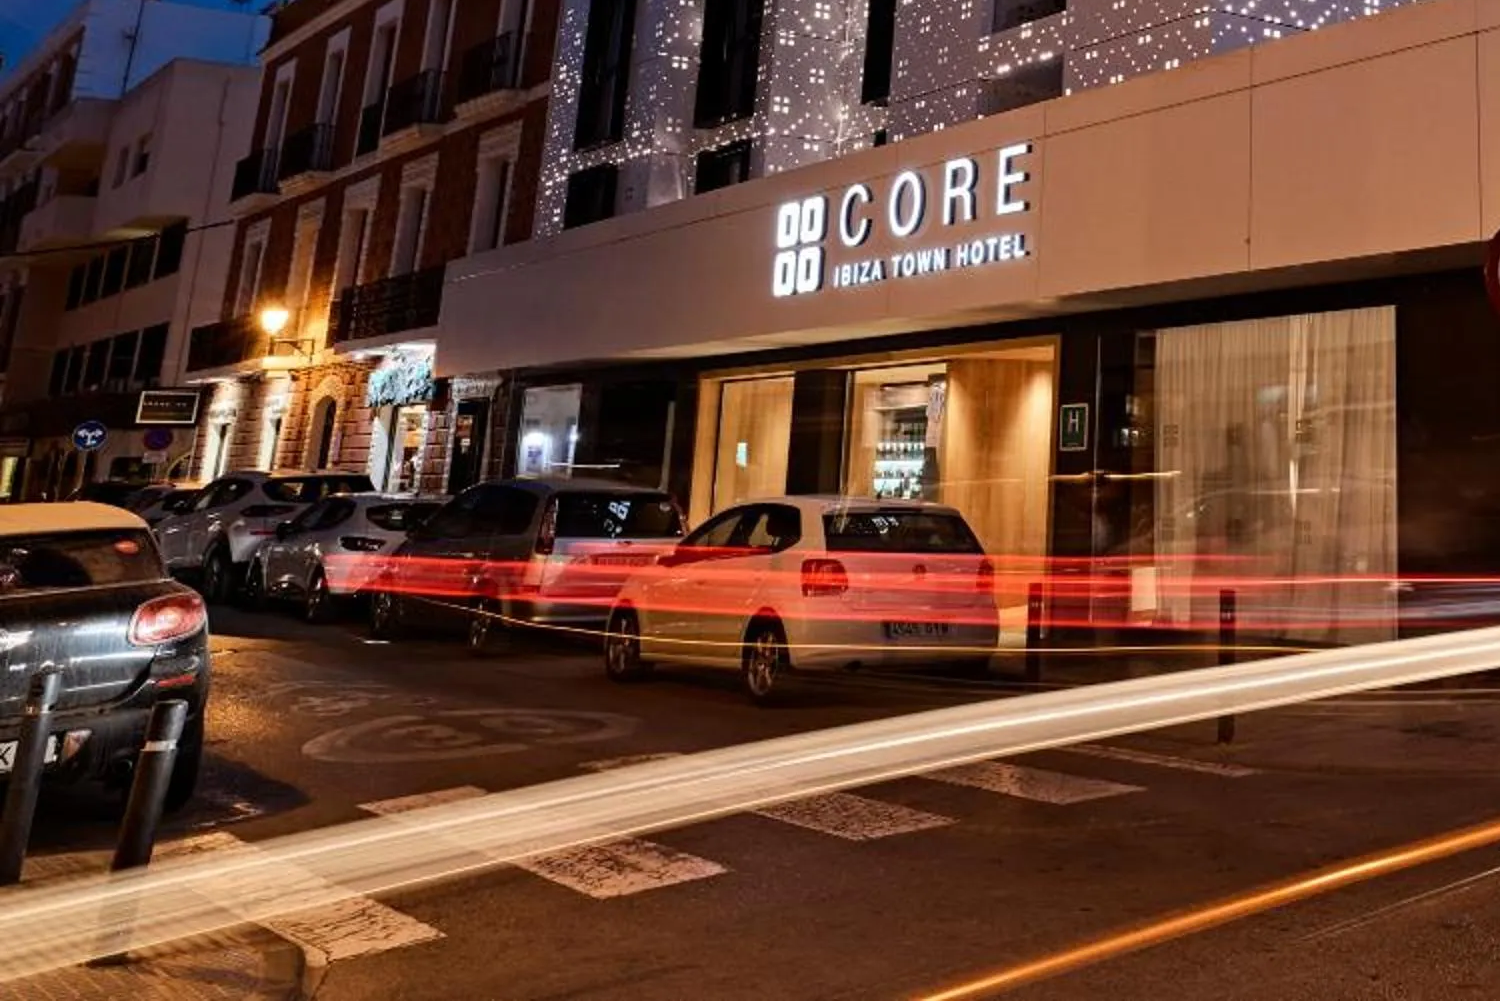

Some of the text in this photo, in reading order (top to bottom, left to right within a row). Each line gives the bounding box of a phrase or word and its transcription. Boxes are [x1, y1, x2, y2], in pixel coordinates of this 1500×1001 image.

[840, 143, 1032, 247] CORE
[833, 234, 1029, 287] IBIZA TOWN HOTEL
